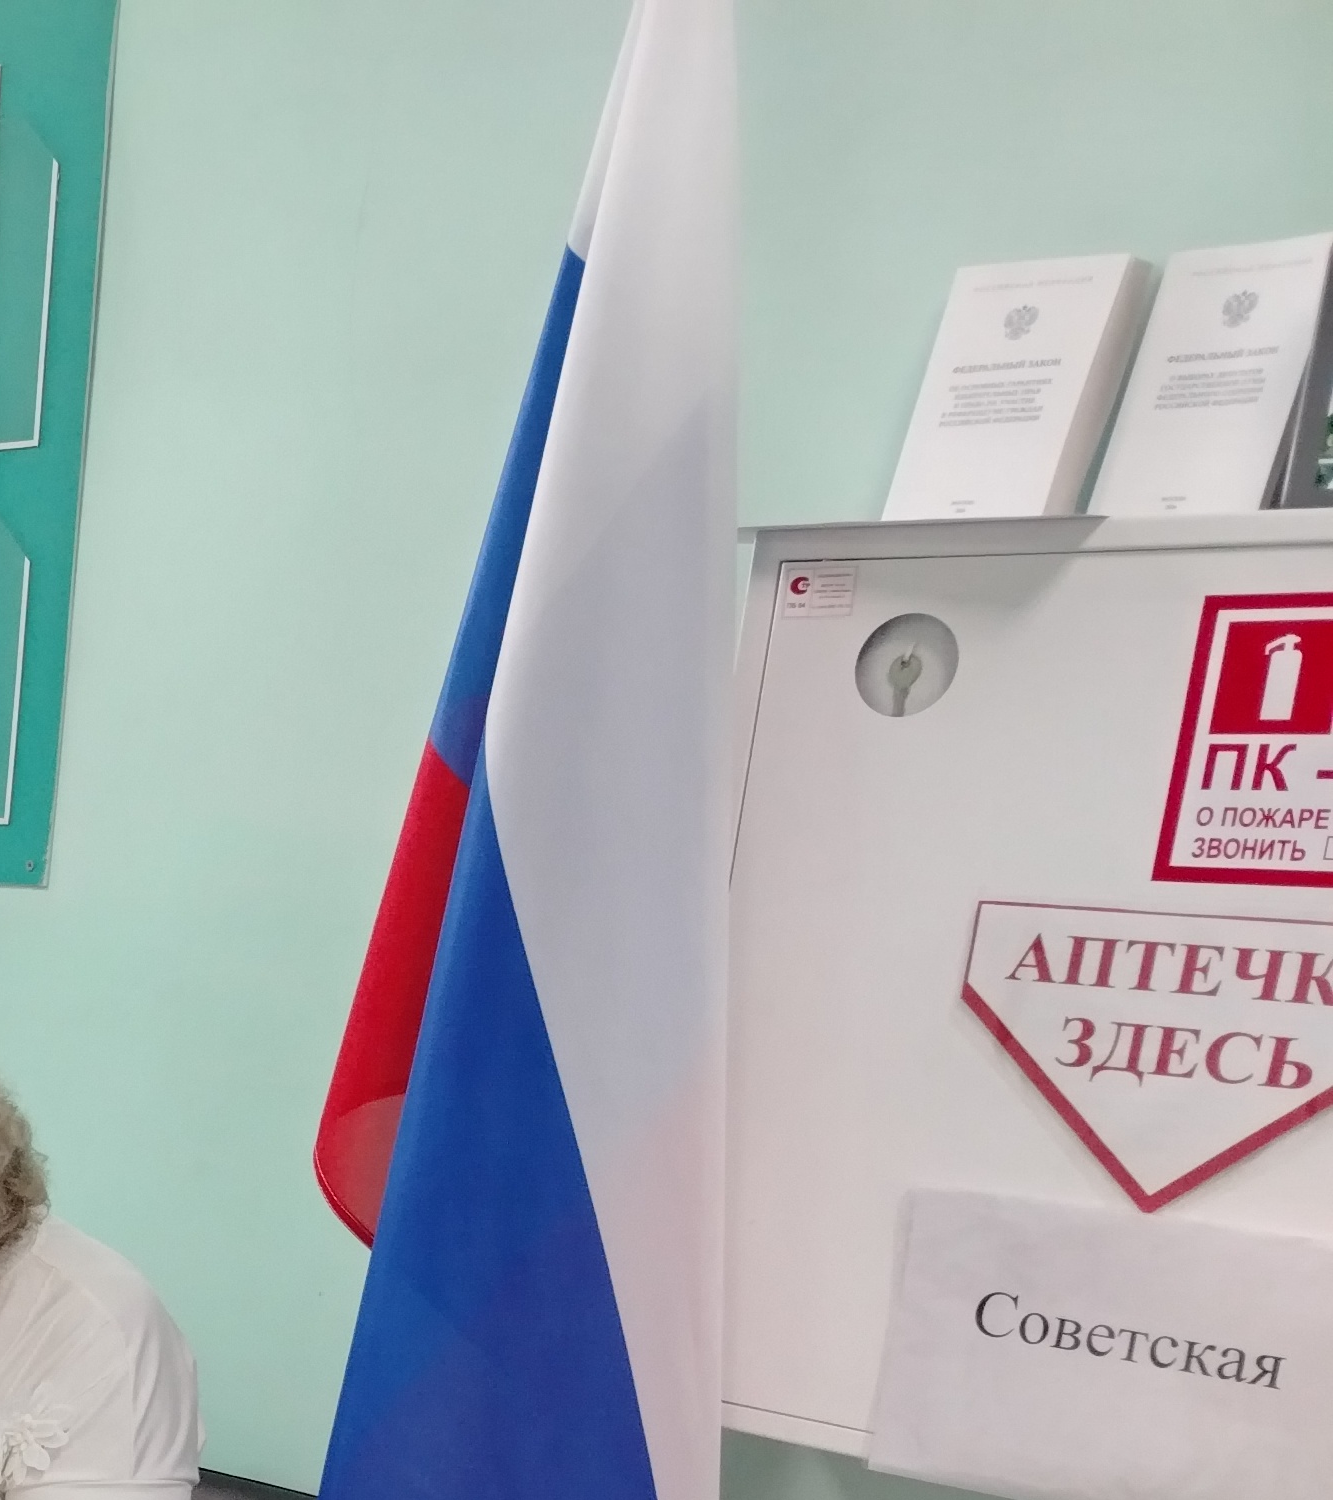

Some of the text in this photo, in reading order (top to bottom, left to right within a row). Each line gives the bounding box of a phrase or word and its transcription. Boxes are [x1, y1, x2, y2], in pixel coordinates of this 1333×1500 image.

[1201, 743, 1297, 791] ПК
[1196, 806, 1331, 829] О ПОЖАРЕ
[1191, 837, 1306, 861] ЗВОНИТЬ
[1004, 932, 1333, 1007] АПТЕЧК
[1055, 1016, 1315, 1091] ЗДЕСЬ
[974, 1291, 1287, 1390] Советская
